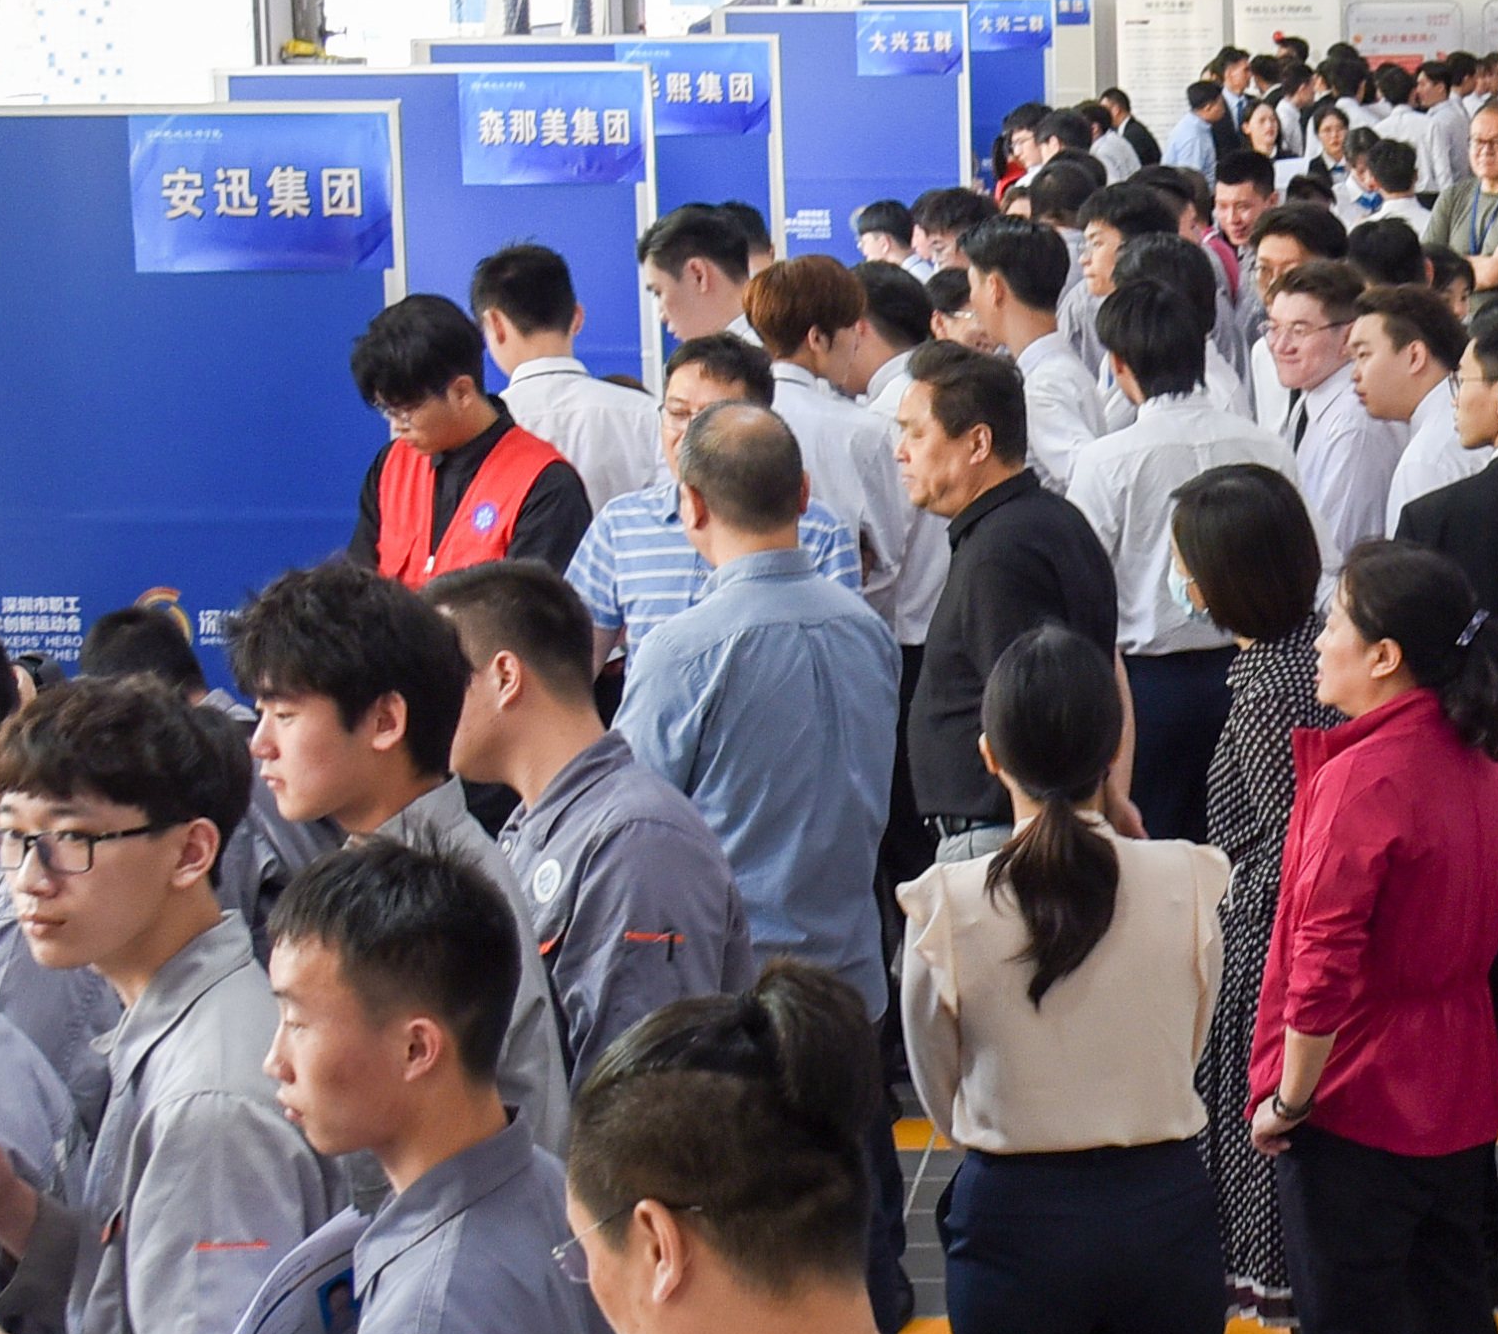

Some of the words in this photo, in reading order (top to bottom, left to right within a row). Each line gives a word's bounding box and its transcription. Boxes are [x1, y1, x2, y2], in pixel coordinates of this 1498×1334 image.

[868, 30, 953, 54] 大兴五群
[477, 107, 632, 148] 森那美集团
[160, 165, 365, 221] 安迅集团
